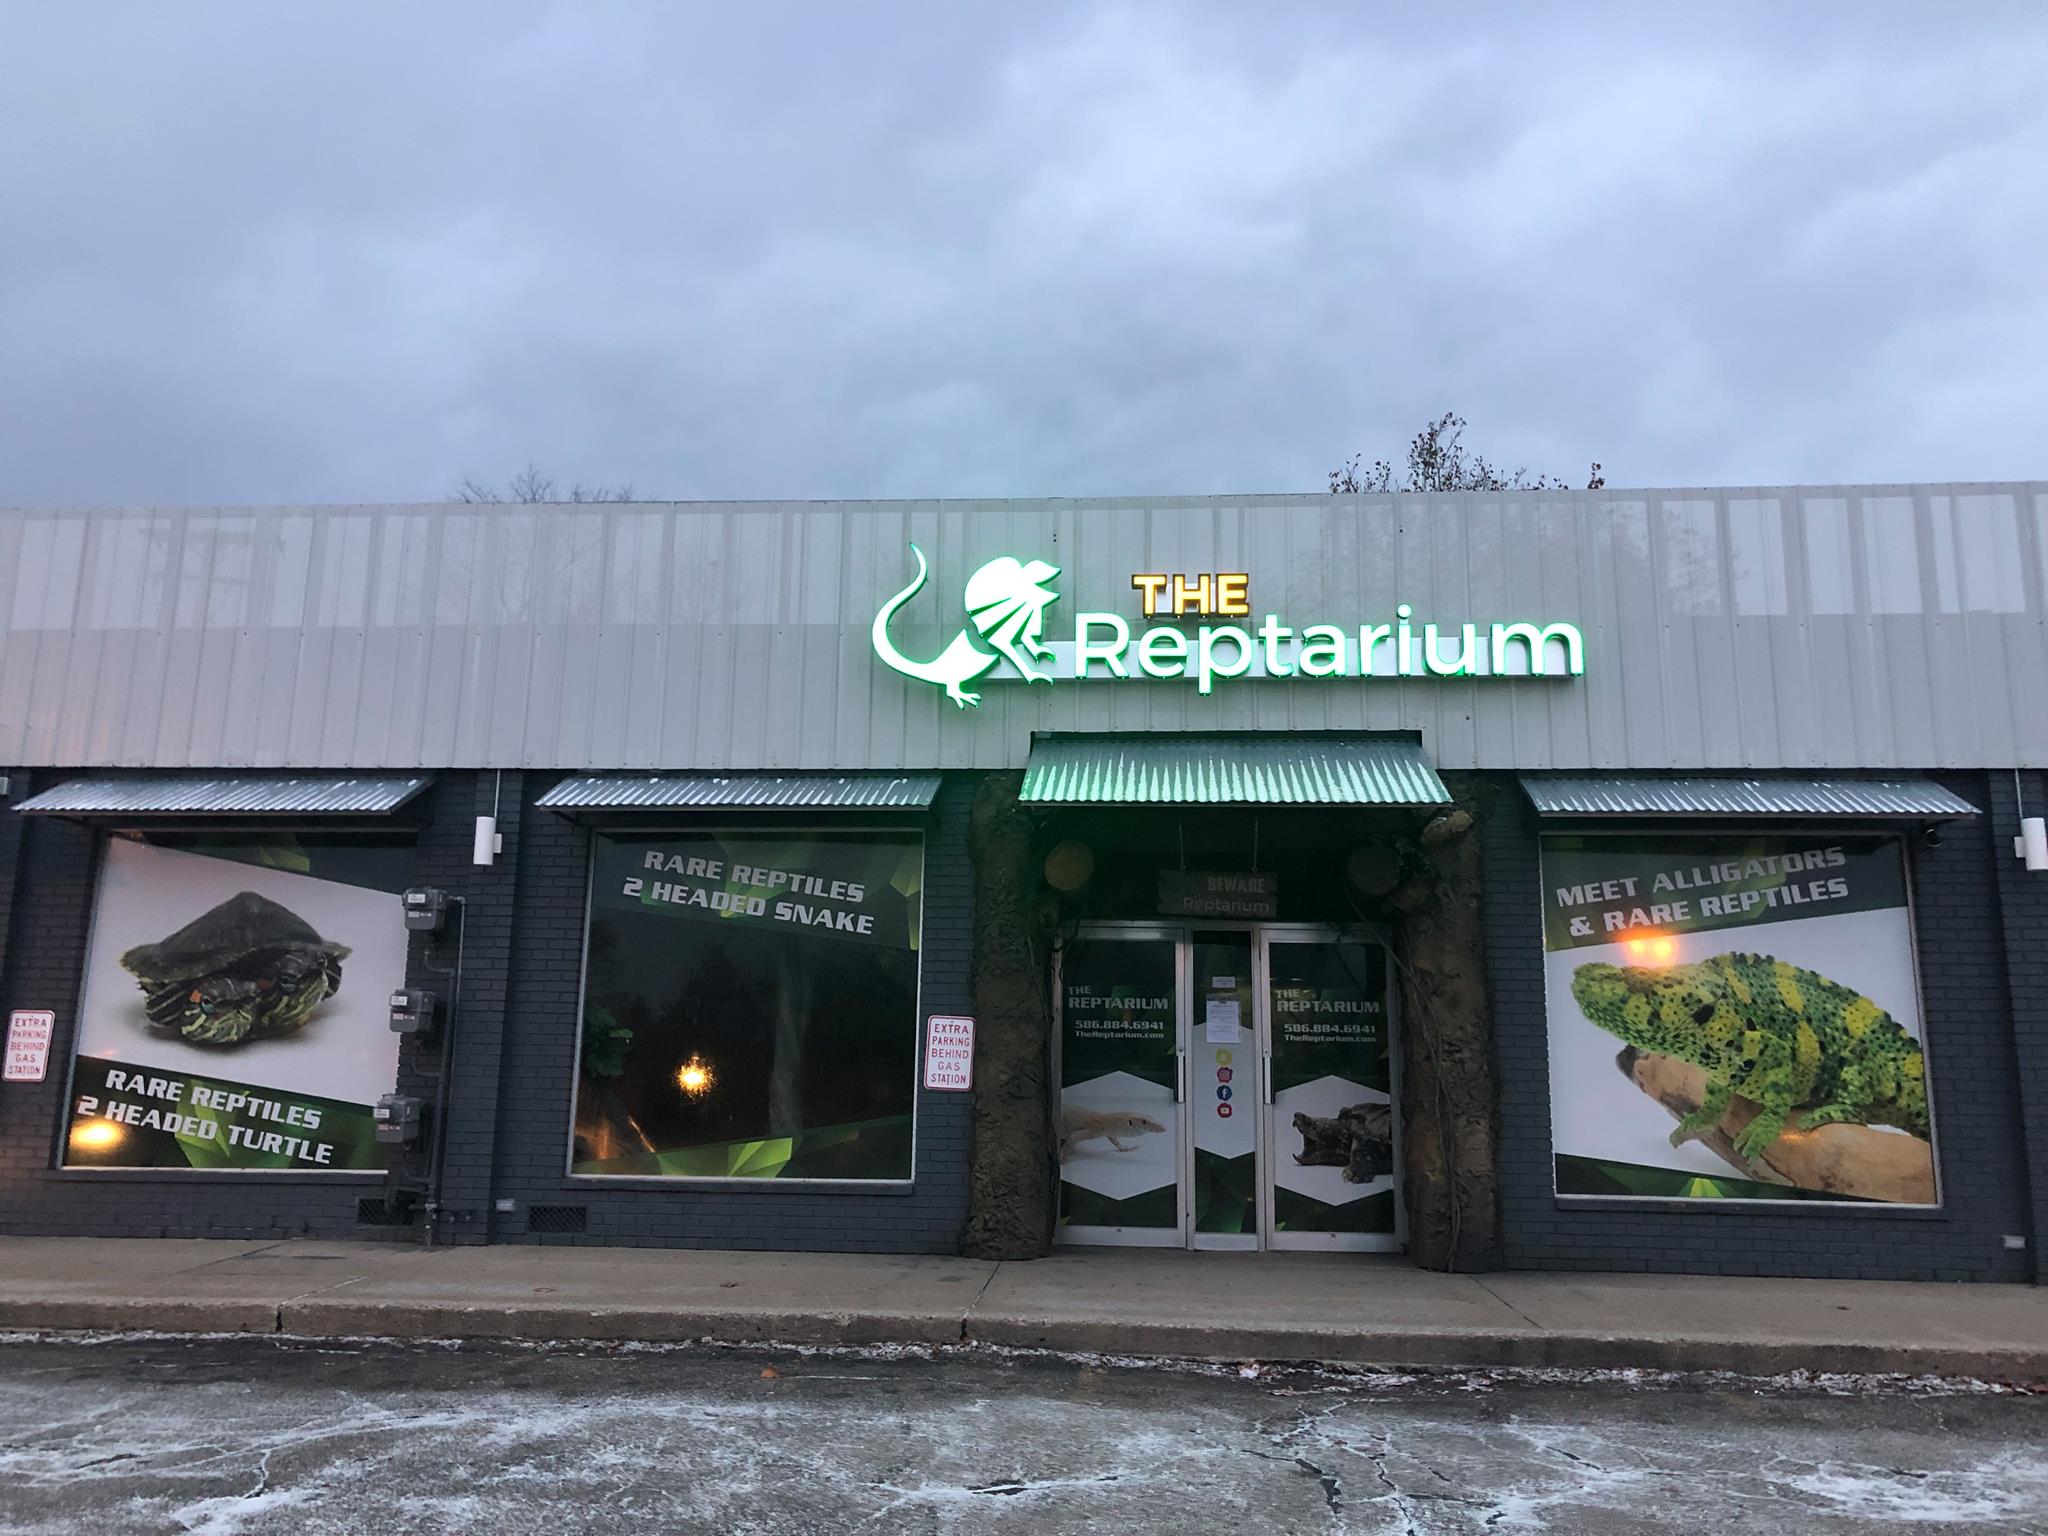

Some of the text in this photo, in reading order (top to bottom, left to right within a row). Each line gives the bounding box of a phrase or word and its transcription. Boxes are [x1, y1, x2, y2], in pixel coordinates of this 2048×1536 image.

[1132, 574, 1249, 617] THE
[1074, 604, 1584, 696] Reptarium
[644, 850, 865, 903] RARE REPTILES
[1556, 846, 1847, 908] MEET ALLIGATORS
[1207, 877, 1265, 893] BEWARE
[623, 877, 875, 935] 2 HEADED SNAKE
[1183, 896, 1270, 913] Reptarium
[1569, 878, 1849, 937] & RARE REPTILES
[1068, 985, 1092, 995] THE
[1275, 989, 1300, 999] THE
[1068, 997, 1169, 1010] REPTARIUM
[1276, 1000, 1380, 1013] REPTARIUM
[15, 1018, 47, 1028] EXTRA
[1075, 1020, 1164, 1030] 586.884.6941
[1284, 1023, 1376, 1033] 586.884.6941
[934, 1024, 969, 1034] EXTRA
[1075, 1030, 1165, 1039] TheReptarium.com
[12, 1030, 48, 1040] PARKING
[1284, 1034, 1377, 1043] TheReptarium.com
[10, 1041, 45, 1051] BEHIND
[932, 1036, 970, 1047] PARKING
[15, 1053, 36, 1063] GAS
[931, 1048, 969, 1059] BEHIND
[8, 1065, 40, 1075] STATION
[937, 1061, 961, 1072] GAS
[930, 1073, 967, 1085] STATION
[105, 1069, 323, 1130] RARE REPTILES
[77, 1095, 334, 1165] 2 HEADED TURTLE
